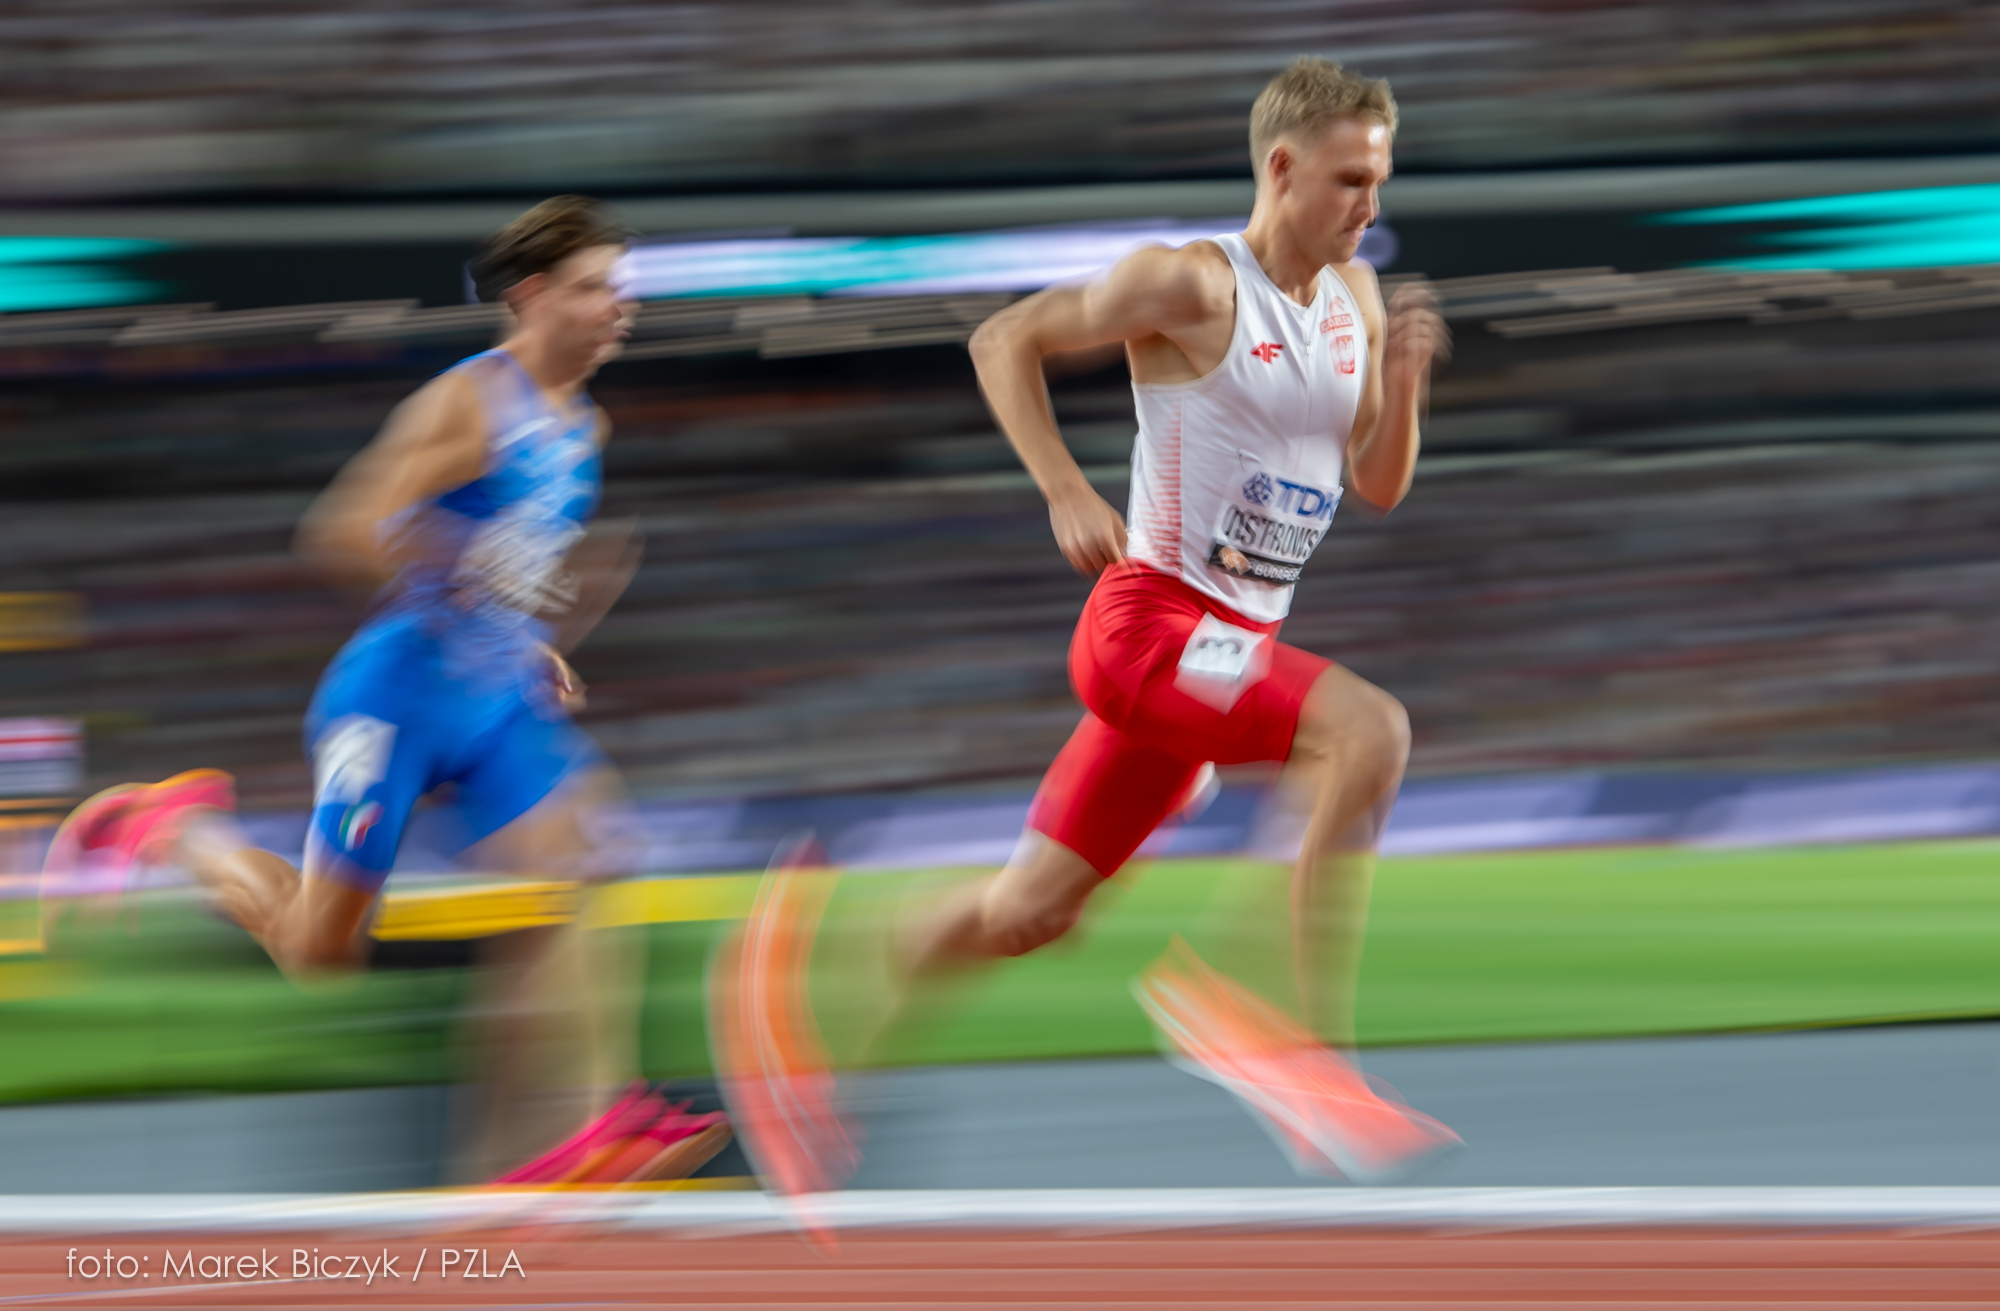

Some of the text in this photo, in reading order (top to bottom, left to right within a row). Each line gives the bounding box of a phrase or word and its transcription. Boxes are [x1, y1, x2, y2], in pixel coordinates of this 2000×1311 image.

[1250, 341, 1285, 365] 4F
[1275, 477, 1341, 521] TDK
[1222, 504, 1323, 559] OSTROWS
